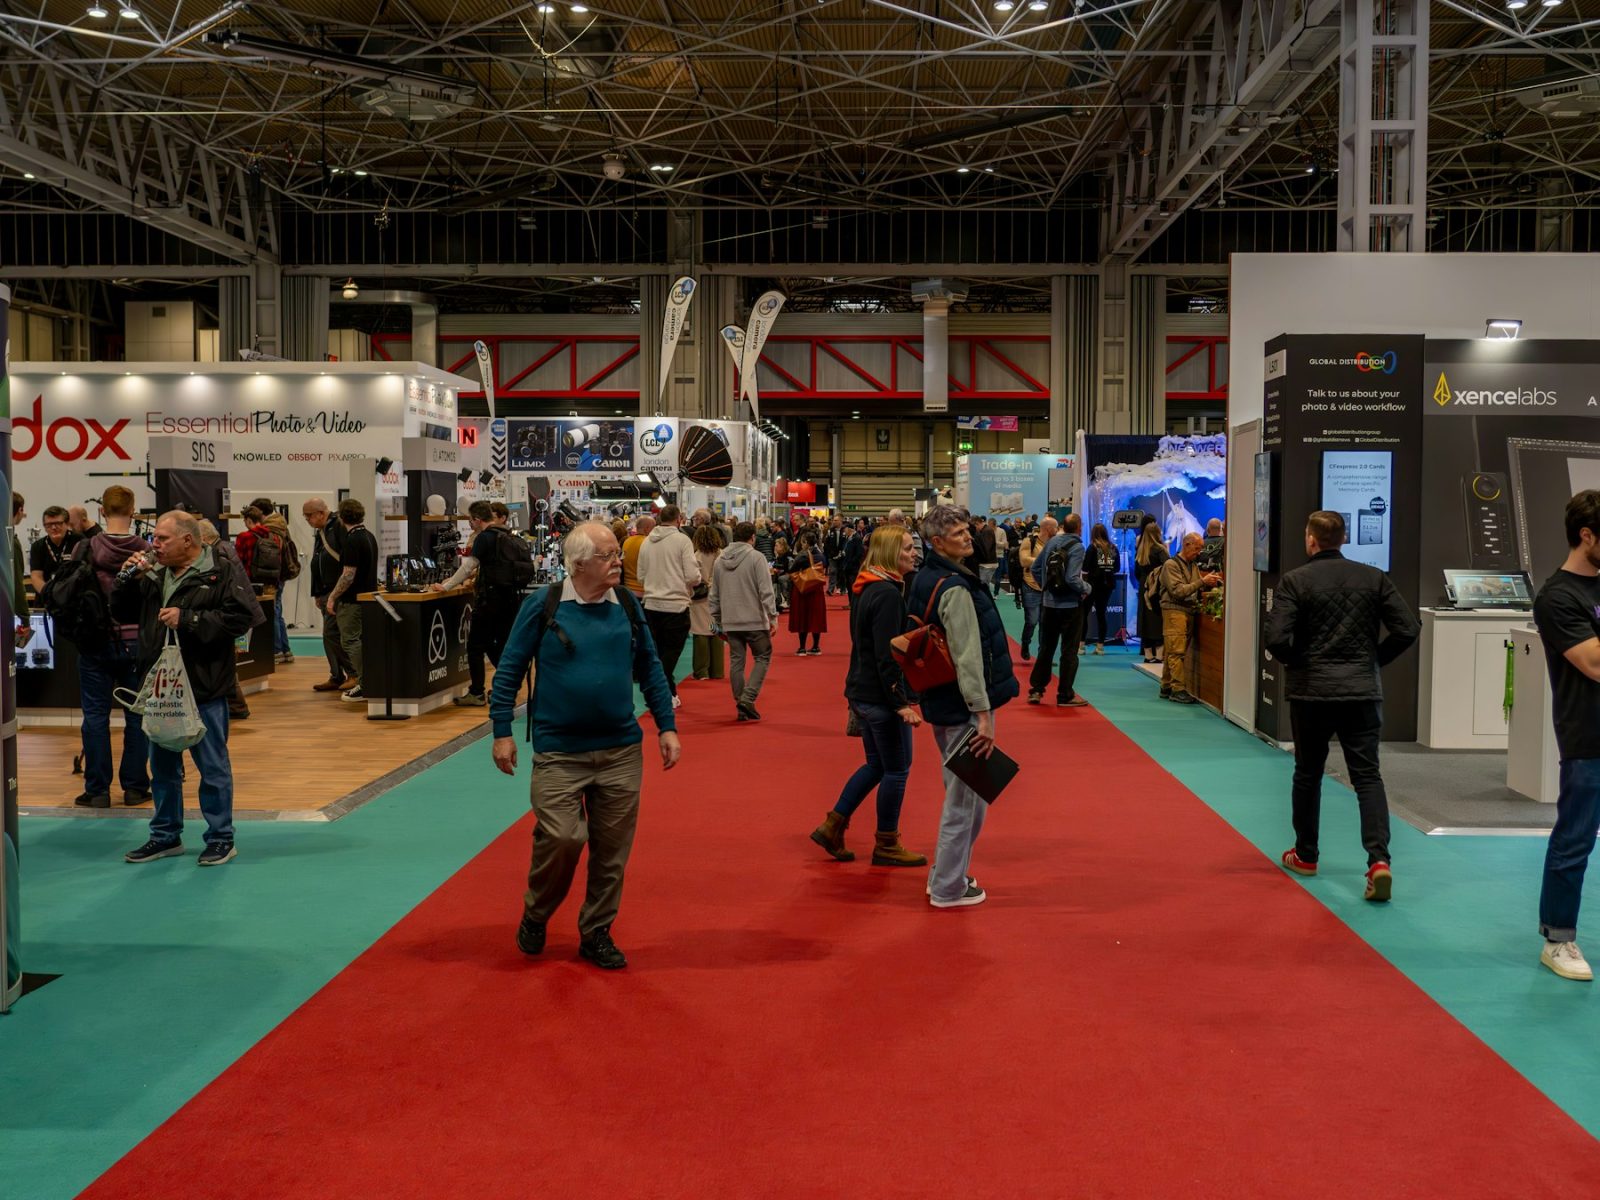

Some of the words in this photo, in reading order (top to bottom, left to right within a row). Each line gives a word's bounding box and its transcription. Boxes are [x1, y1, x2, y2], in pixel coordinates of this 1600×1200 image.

[669, 307, 677, 341] camera
[752, 319, 761, 350] camera
[1307, 389, 1326, 397] Talk
[1351, 389, 1378, 397] about
[1380, 391, 1400, 399] your
[1454, 387, 1557, 406] xencelabs
[1301, 402, 1328, 412] photo
[1330, 403, 1337, 411] &
[1338, 402, 1363, 411] video
[1364, 402, 1406, 411] workflow
[315, 410, 366, 434] Video
[11, 394, 132, 462] dox
[1167, 442, 1222, 453] NEWER
[233, 452, 282, 462] KNOWLED
[287, 453, 323, 461] OBSBOT
[511, 459, 546, 468] LUMIX
[592, 458, 631, 468] Canon
[428, 665, 448, 683] ATOMOS
[159, 701, 183, 709] plastic
